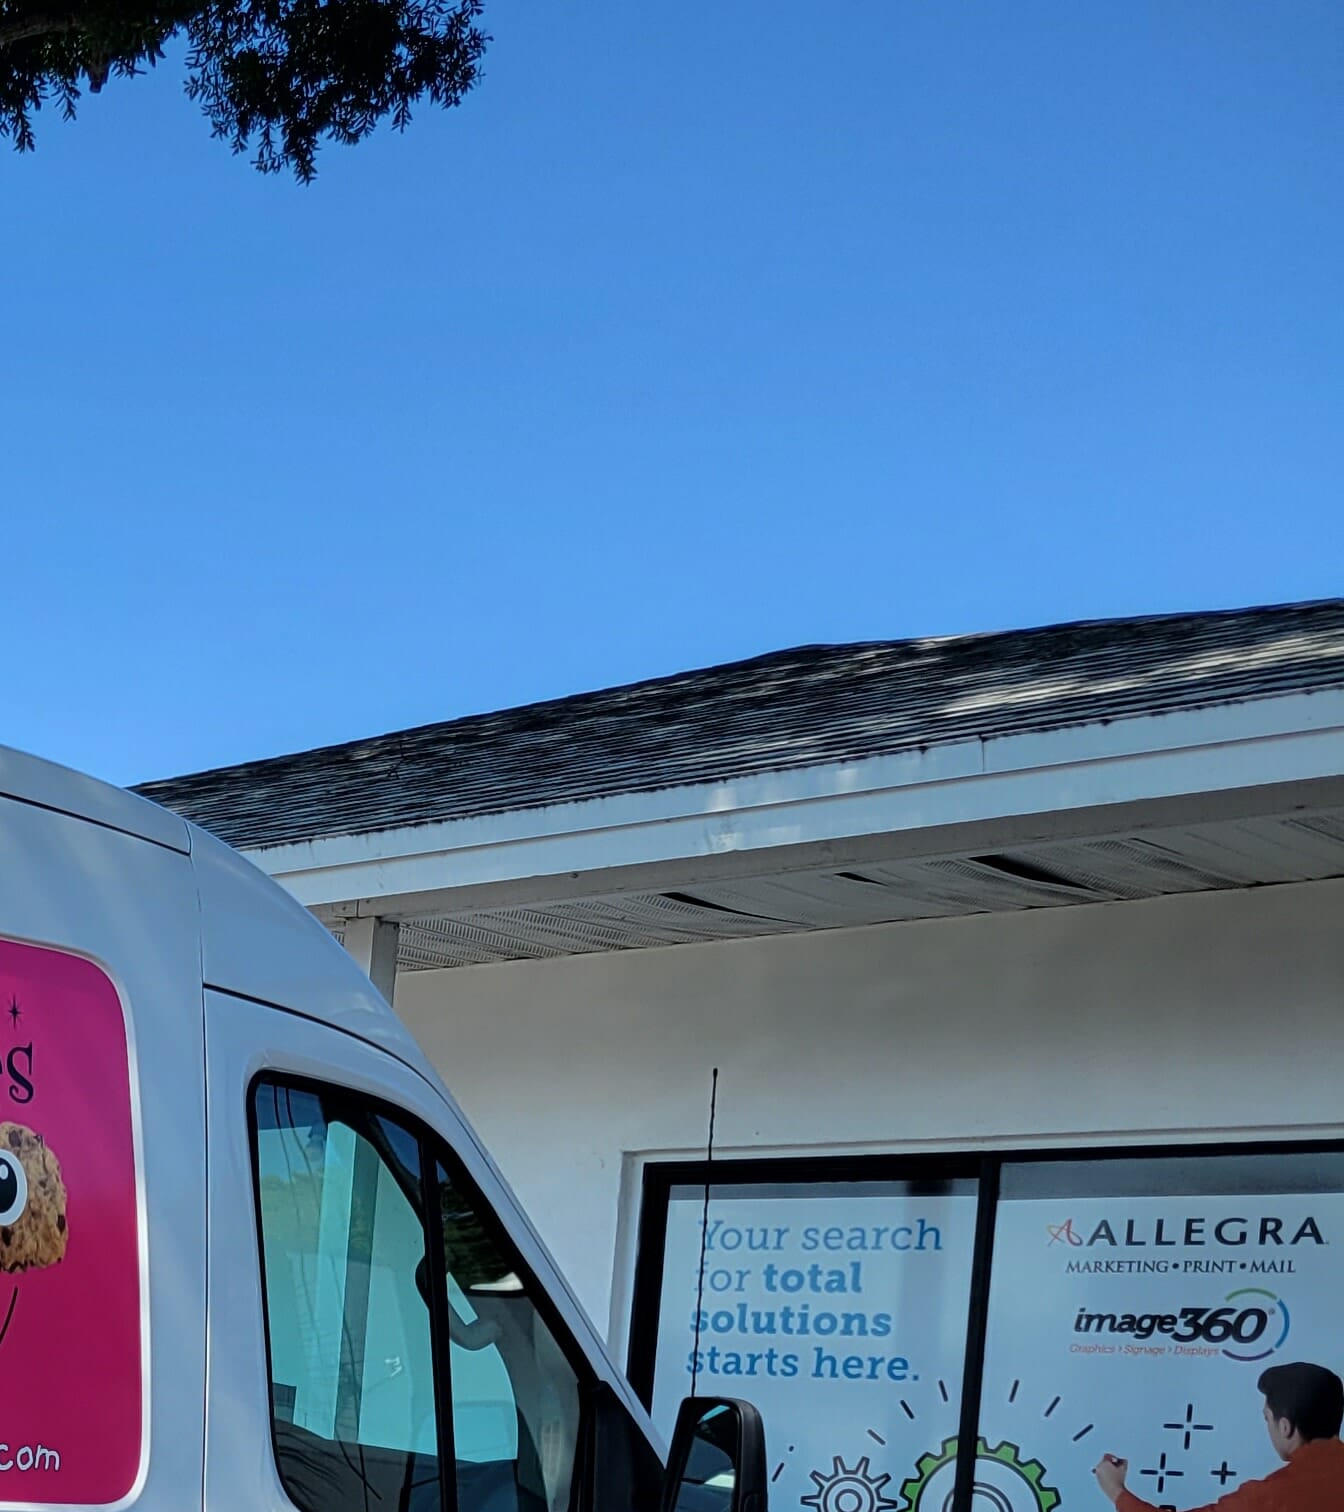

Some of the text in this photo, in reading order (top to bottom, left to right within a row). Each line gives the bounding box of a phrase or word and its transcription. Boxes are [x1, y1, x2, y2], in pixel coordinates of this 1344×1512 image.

[698, 1218, 942, 1251] Your search
[1085, 1217, 1325, 1247] ALLEGRA
[763, 1262, 863, 1293] total
[1065, 1259, 1297, 1274] MARKETING PRINT MAIL
[690, 1303, 892, 1336] solutions
[1073, 1307, 1269, 1345] image360
[686, 1347, 920, 1381] starts here.
[1070, 1343, 1220, 1358] Graphics Signage Displays
